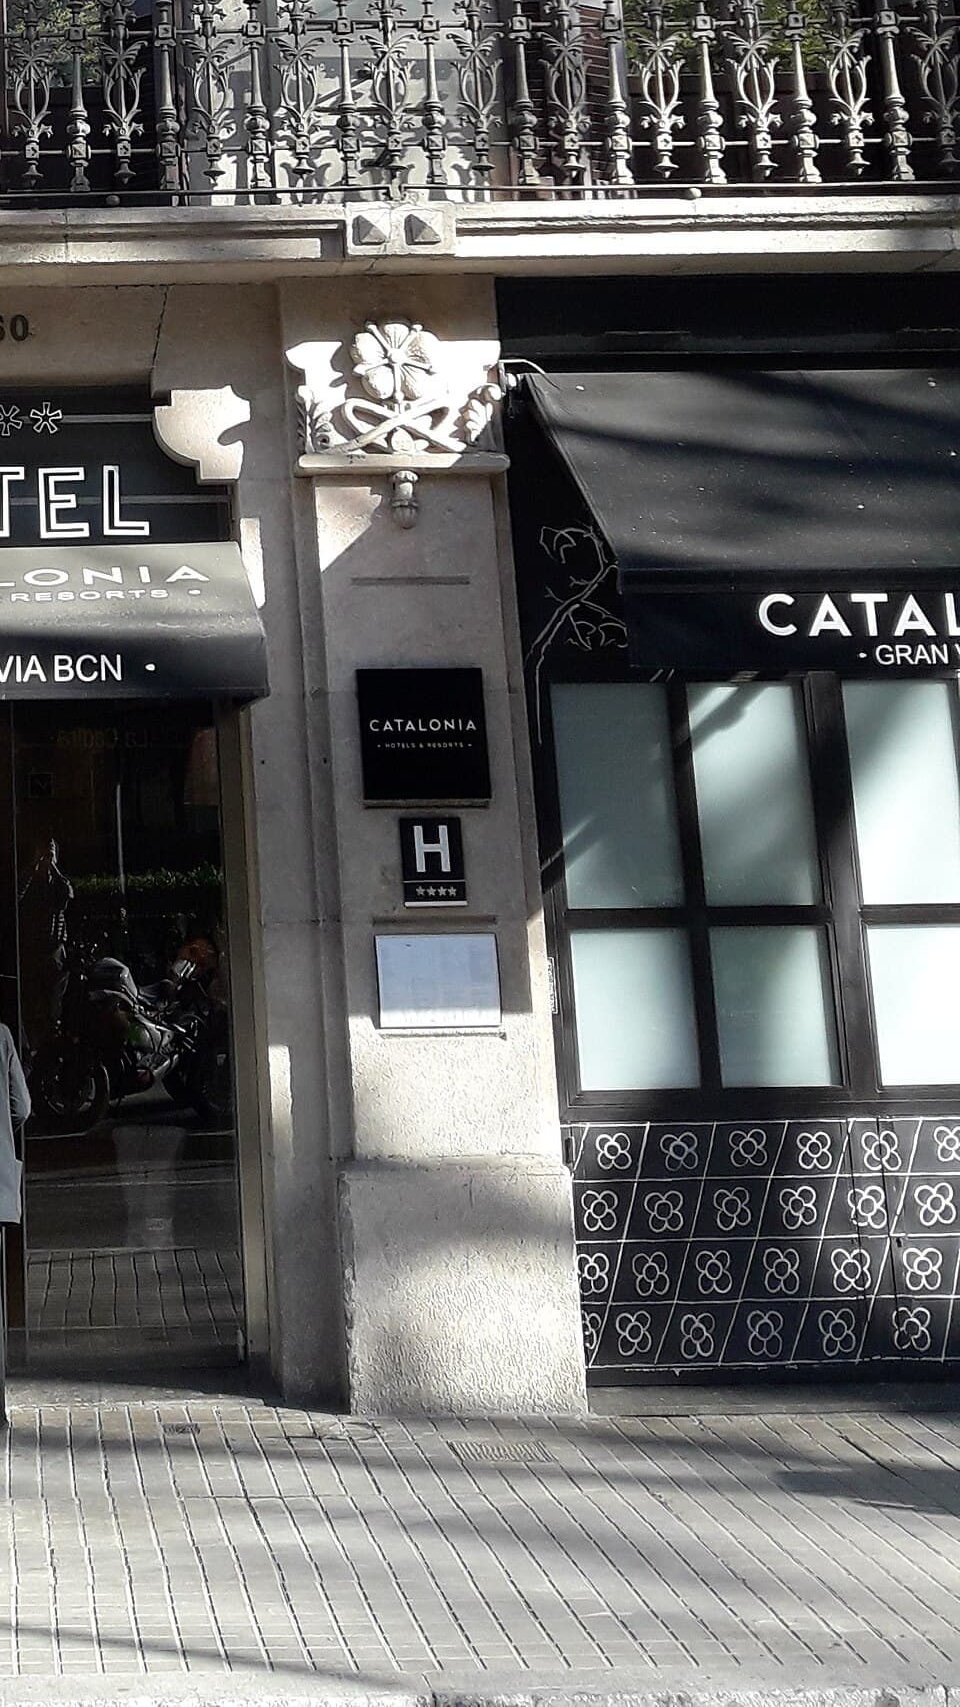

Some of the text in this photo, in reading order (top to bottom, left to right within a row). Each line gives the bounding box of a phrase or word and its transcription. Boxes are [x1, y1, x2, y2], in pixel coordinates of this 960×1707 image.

[10, 589, 169, 602] RESORTS
[876, 643, 949, 665] GRAN
[54, 654, 122, 681] BCN
[369, 718, 477, 732] CATALONIA
[413, 825, 451, 873] H
